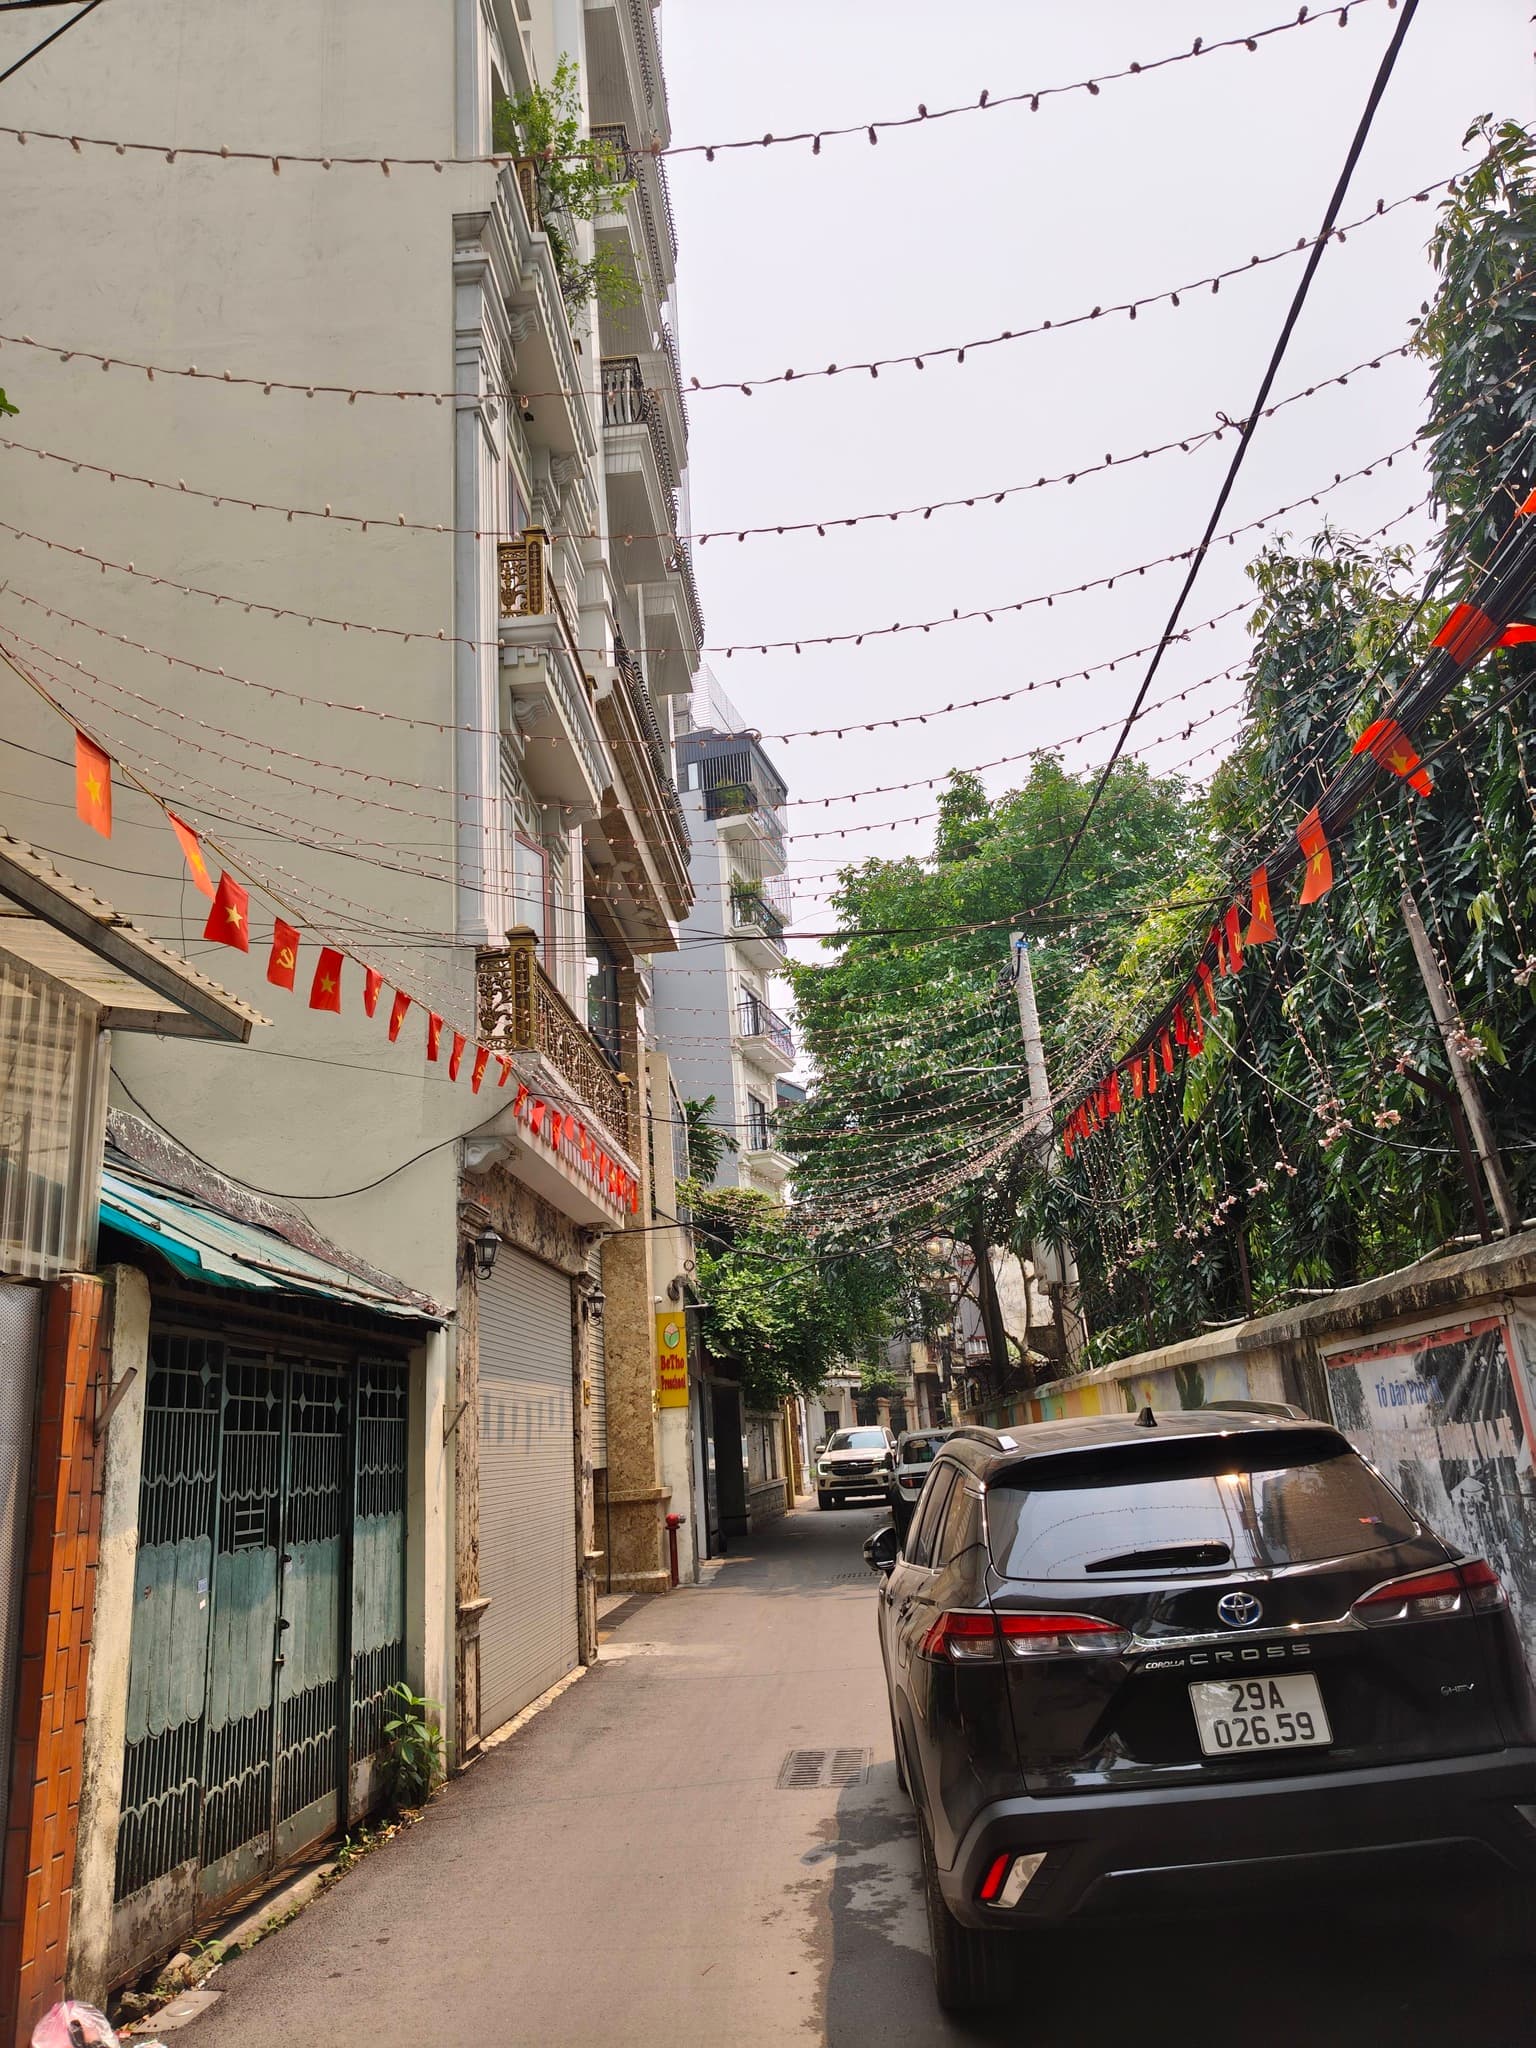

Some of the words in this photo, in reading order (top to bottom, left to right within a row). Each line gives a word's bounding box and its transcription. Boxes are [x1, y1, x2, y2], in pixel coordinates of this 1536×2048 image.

[1145, 1659, 1185, 1669] COROLLA
[1189, 1643, 1311, 1665] CROSS
[1228, 1680, 1285, 1712] 29A
[1213, 1712, 1316, 1748] 026.59
